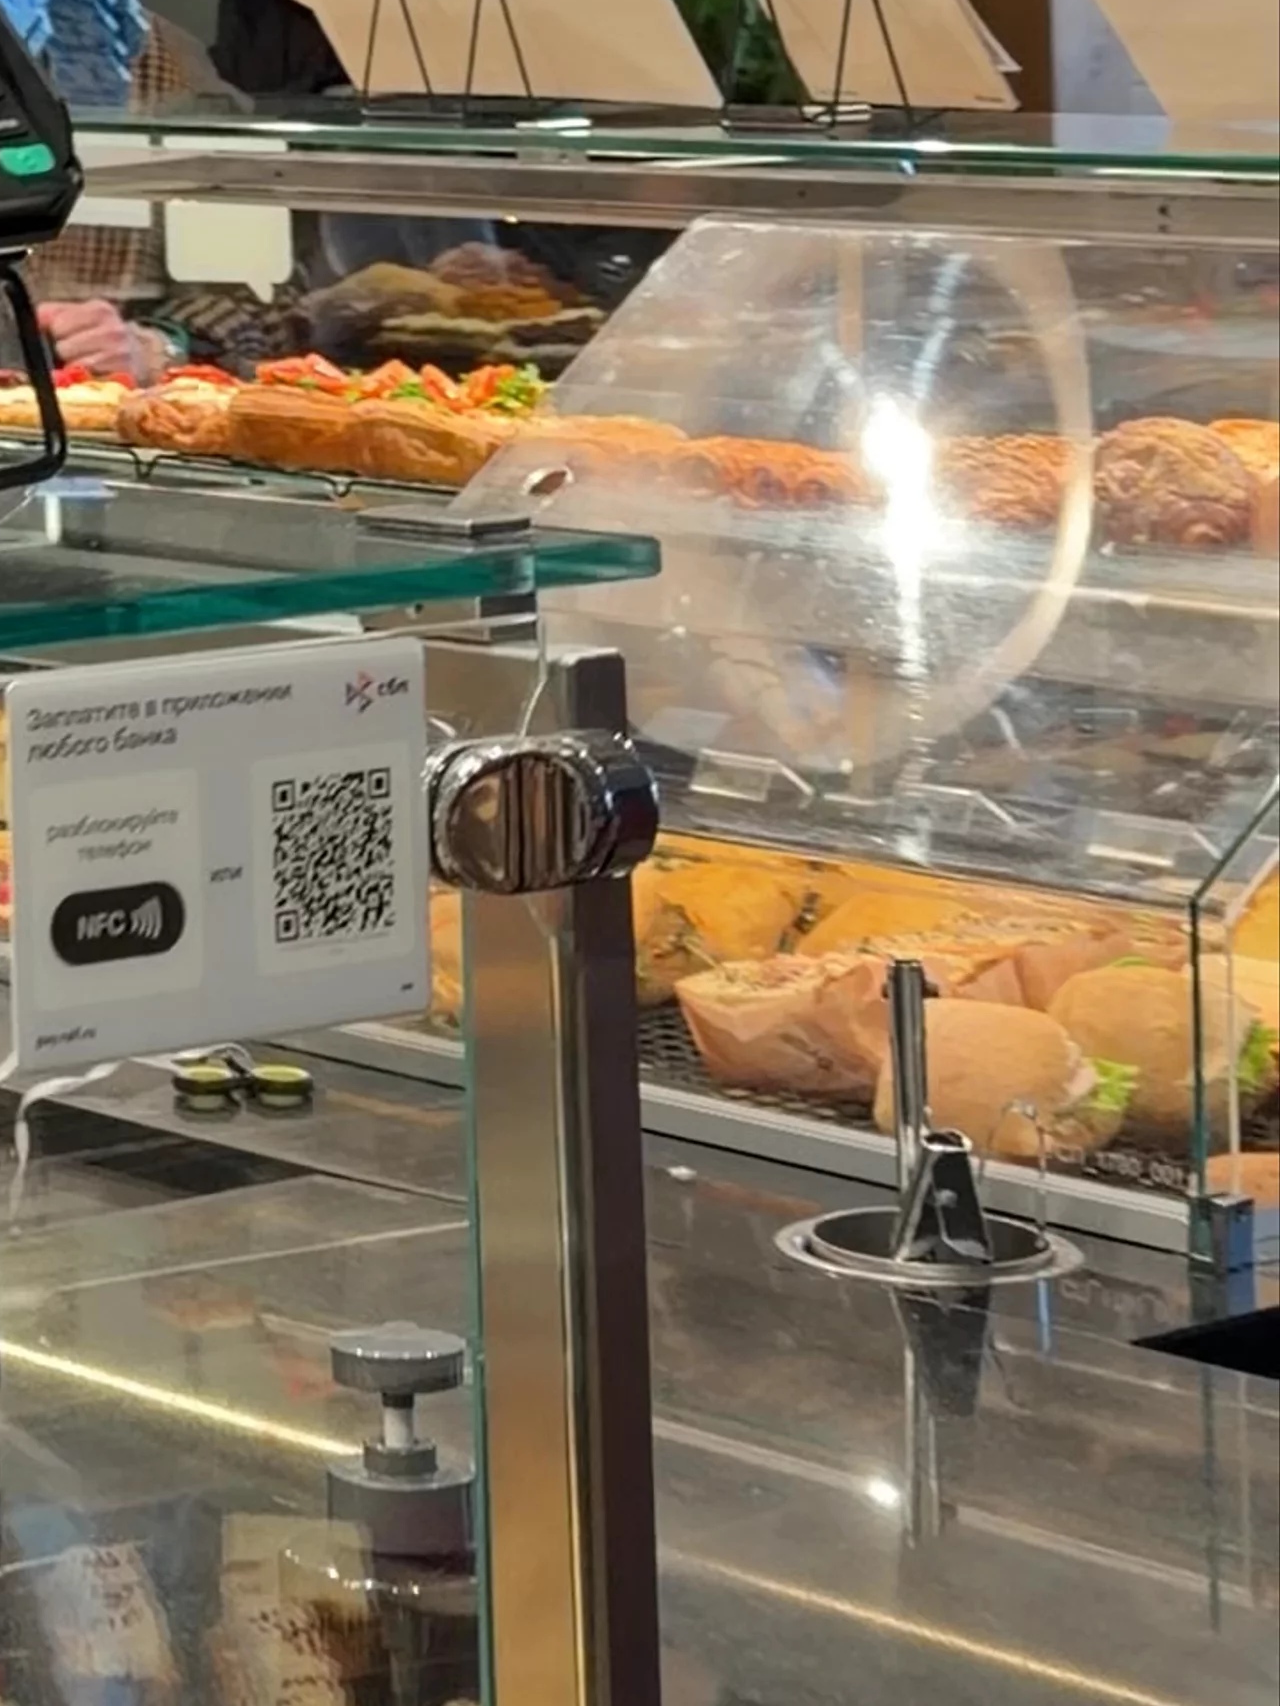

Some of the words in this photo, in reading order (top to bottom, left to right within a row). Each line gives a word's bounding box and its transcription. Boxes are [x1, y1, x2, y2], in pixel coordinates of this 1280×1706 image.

[26, 700, 141, 732] Заплатите
[162, 684, 293, 718] приложении
[27, 733, 109, 763] любого
[113, 726, 178, 752] банка
[76, 909, 126, 941] NFC
